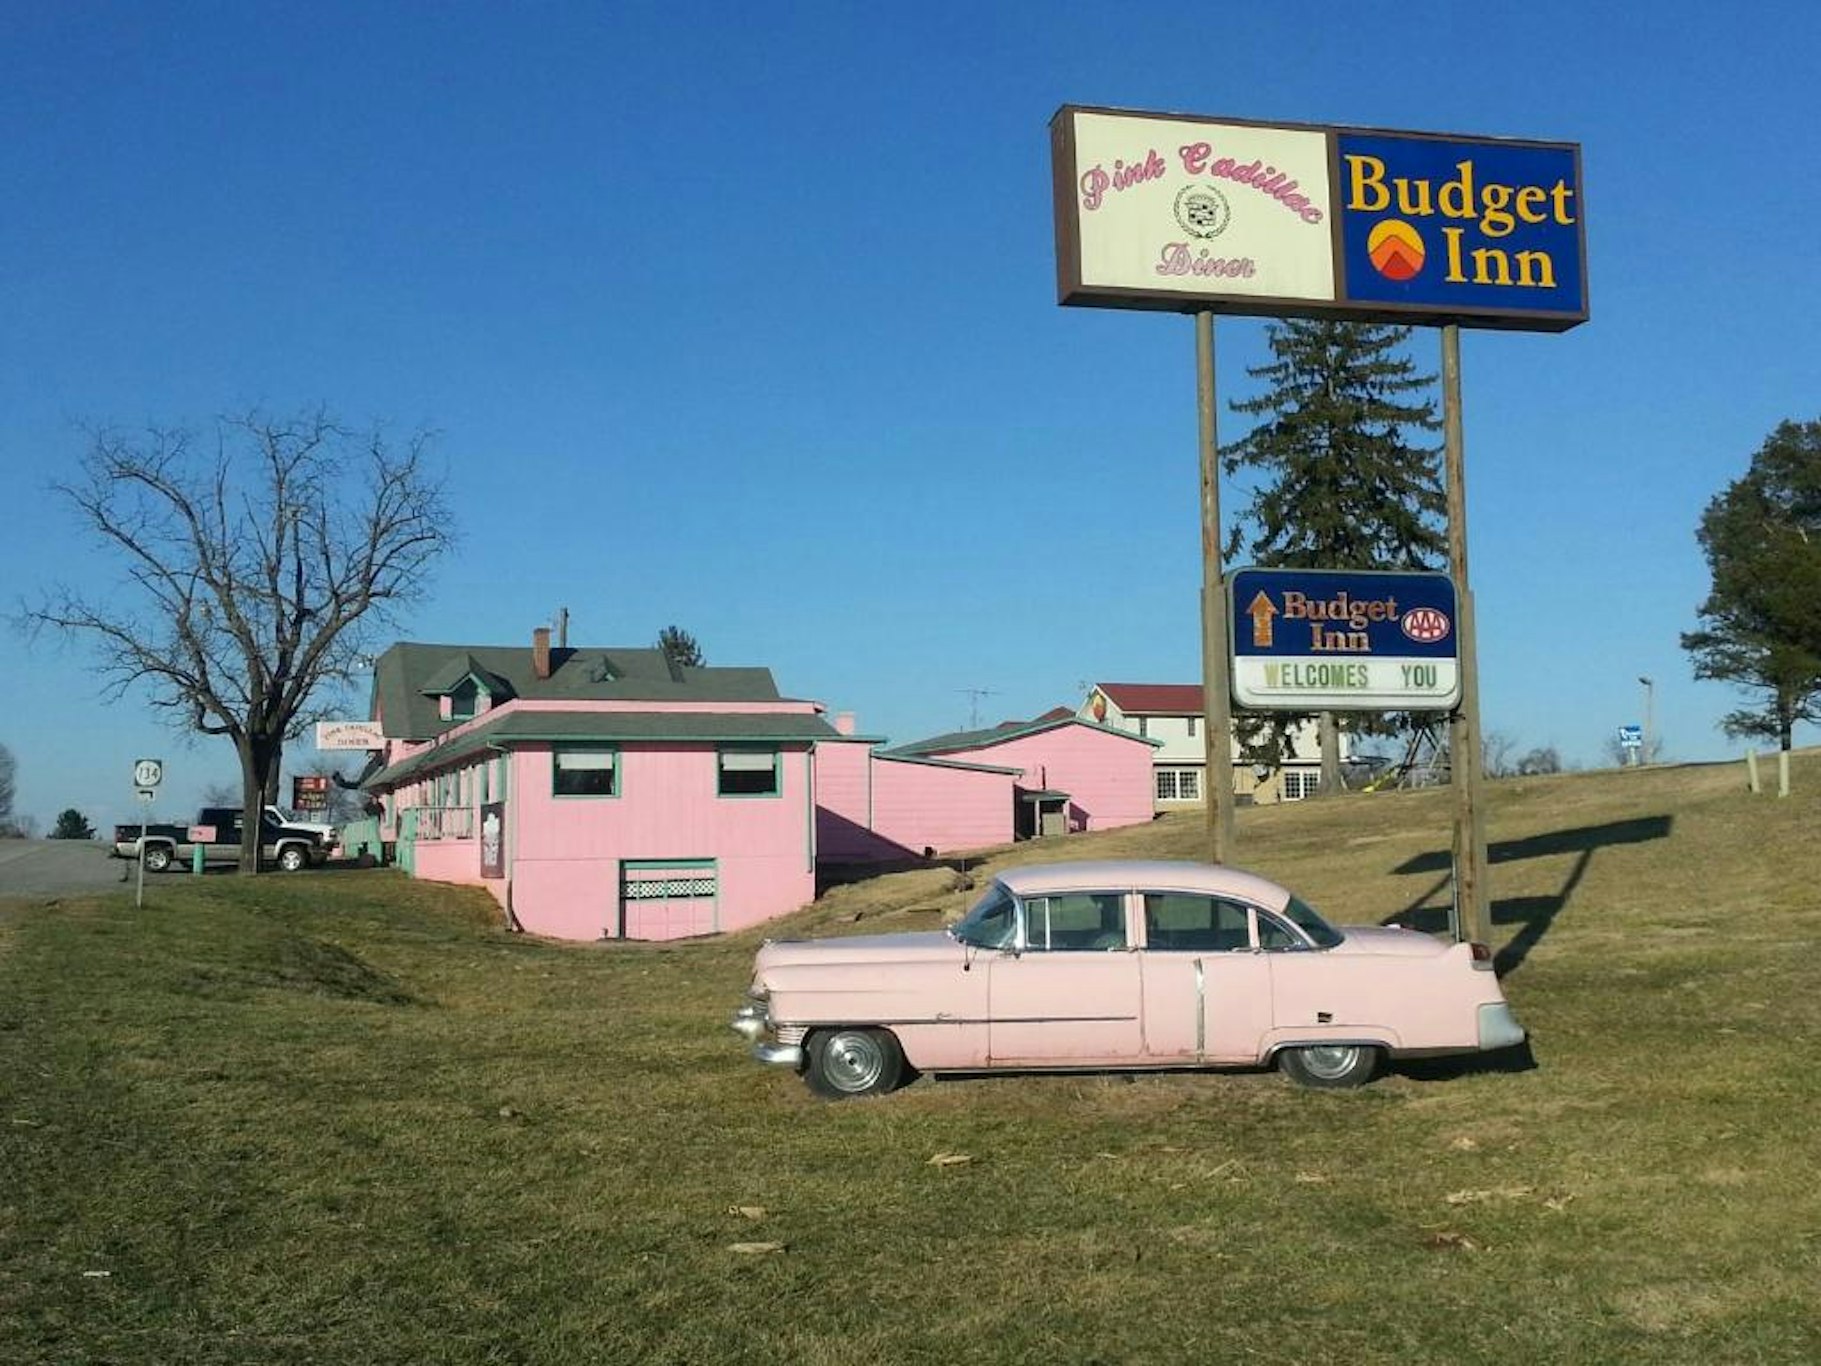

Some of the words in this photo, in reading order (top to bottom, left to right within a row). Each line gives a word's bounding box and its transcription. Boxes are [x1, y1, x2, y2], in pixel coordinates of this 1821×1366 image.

[1080, 149, 1166, 210] Pink
[1178, 142, 1324, 225] Cadillac
[1344, 154, 1576, 238] Budget
[1155, 242, 1257, 278] Diner
[1441, 227, 1557, 288] Inn
[1281, 591, 1400, 630] Budget
[1408, 610, 1444, 639] AAA
[1310, 622, 1372, 652] Inn
[1264, 663, 1369, 687] WELCOMES
[1401, 664, 1437, 687] YOU
